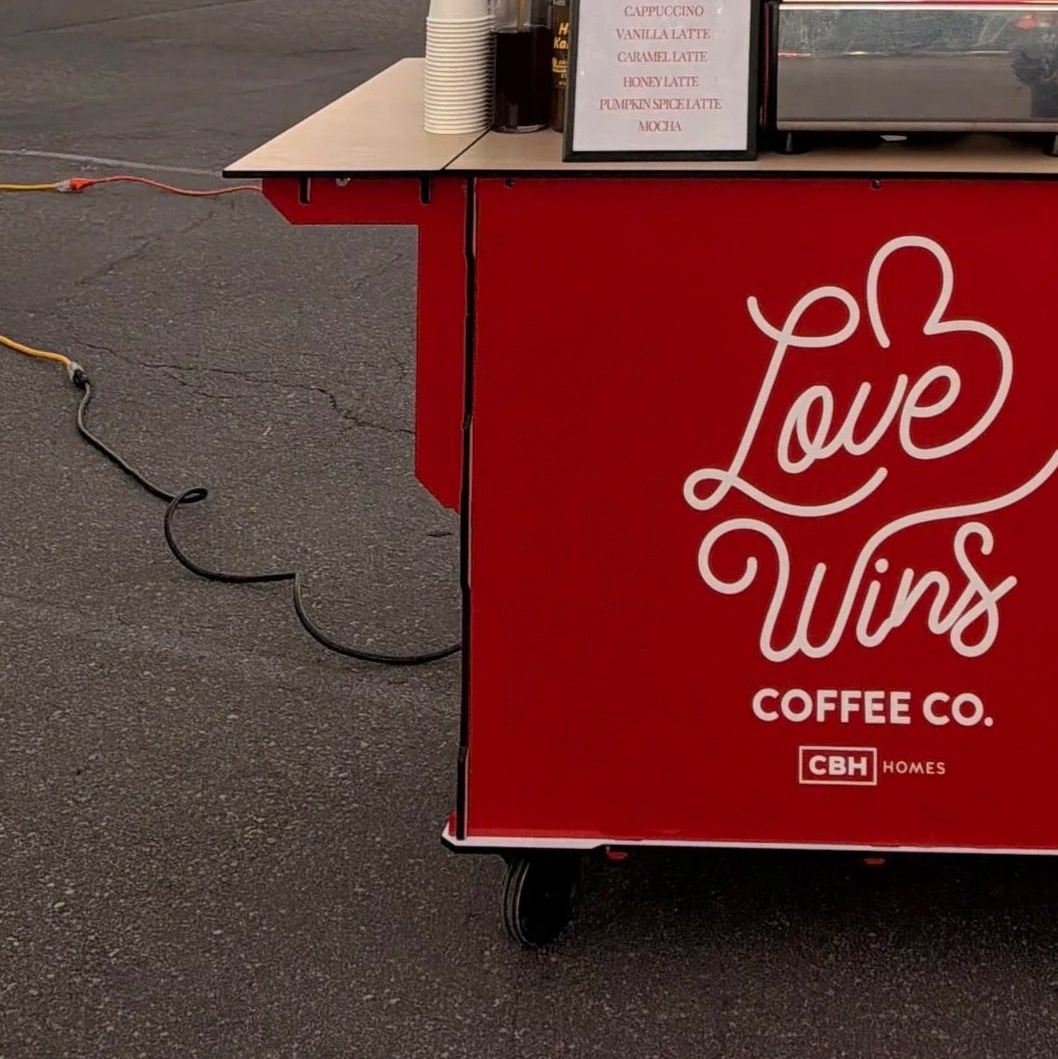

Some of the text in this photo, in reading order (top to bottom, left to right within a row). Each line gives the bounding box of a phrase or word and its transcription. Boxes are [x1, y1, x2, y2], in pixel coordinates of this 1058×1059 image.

[624, 5, 705, 17] CAPPUCCINO
[616, 28, 711, 40] VANILLA LATTE
[617, 51, 708, 63] CARAMEL LATTE
[623, 76, 700, 88] HONEY LATTE
[599, 98, 722, 110] PUMPKIN SPICE LATTE
[638, 120, 682, 132] MOCHA
[683, 235, 1013, 517] Love
[752, 687, 994, 727] COFFEE CO.
[808, 754, 947, 776] CBH HOMES
